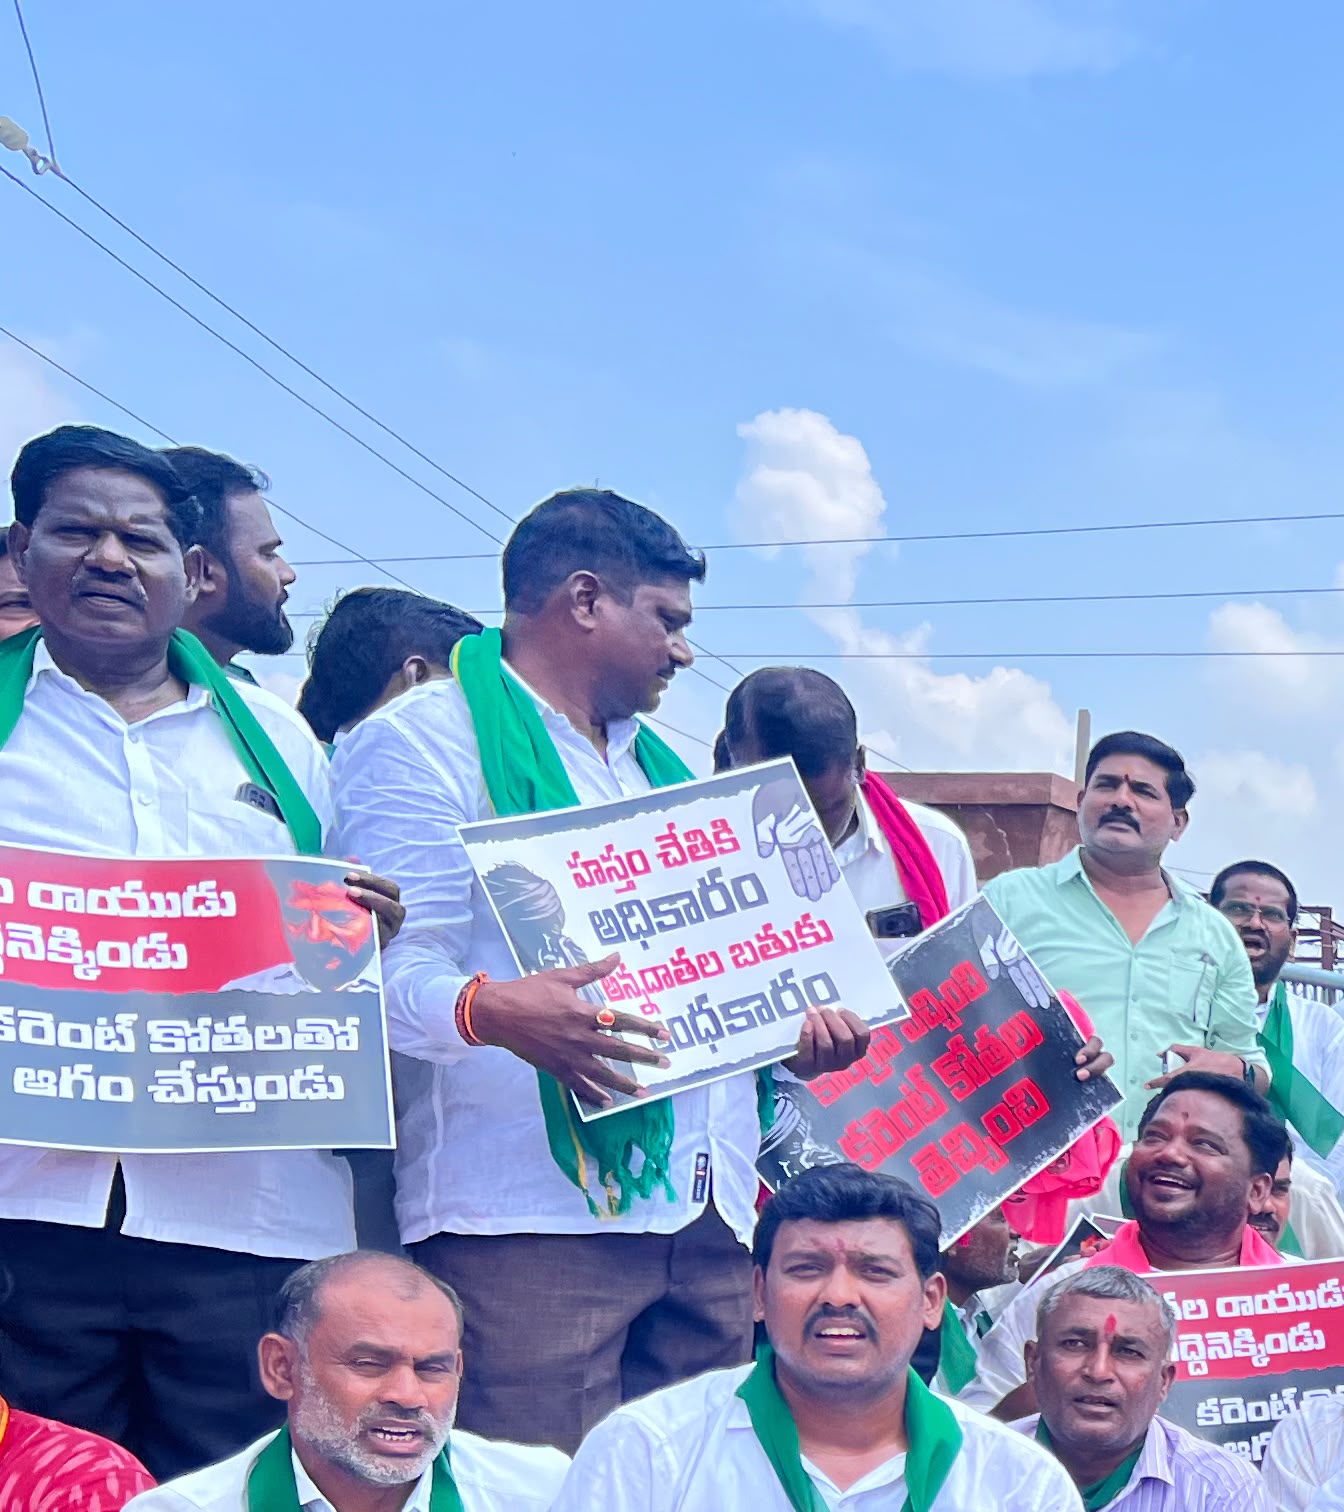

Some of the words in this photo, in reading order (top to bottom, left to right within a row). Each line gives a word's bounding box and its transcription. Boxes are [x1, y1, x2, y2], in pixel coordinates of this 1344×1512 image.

[567, 845, 651, 894] హస్తం
[656, 818, 742, 869] చేతికి
[27, 880, 237, 918] రాయుడు
[588, 868, 769, 951] అధికారం
[601, 947, 724, 1015] అన్నదాతల
[729, 912, 834, 970] బతుకు
[147, 1015, 360, 1053] కోతలతో
[13, 1063, 134, 1102] ఆగం
[147, 1060, 345, 1114] చేస్తుండు
[837, 1063, 949, 1172] కరెంట్
[930, 1010, 1045, 1102] కోతలు
[1170, 1322, 1326, 1376] ద్దెనెక్కిండు
[1196, 1388, 1299, 1427] కరెంట్
